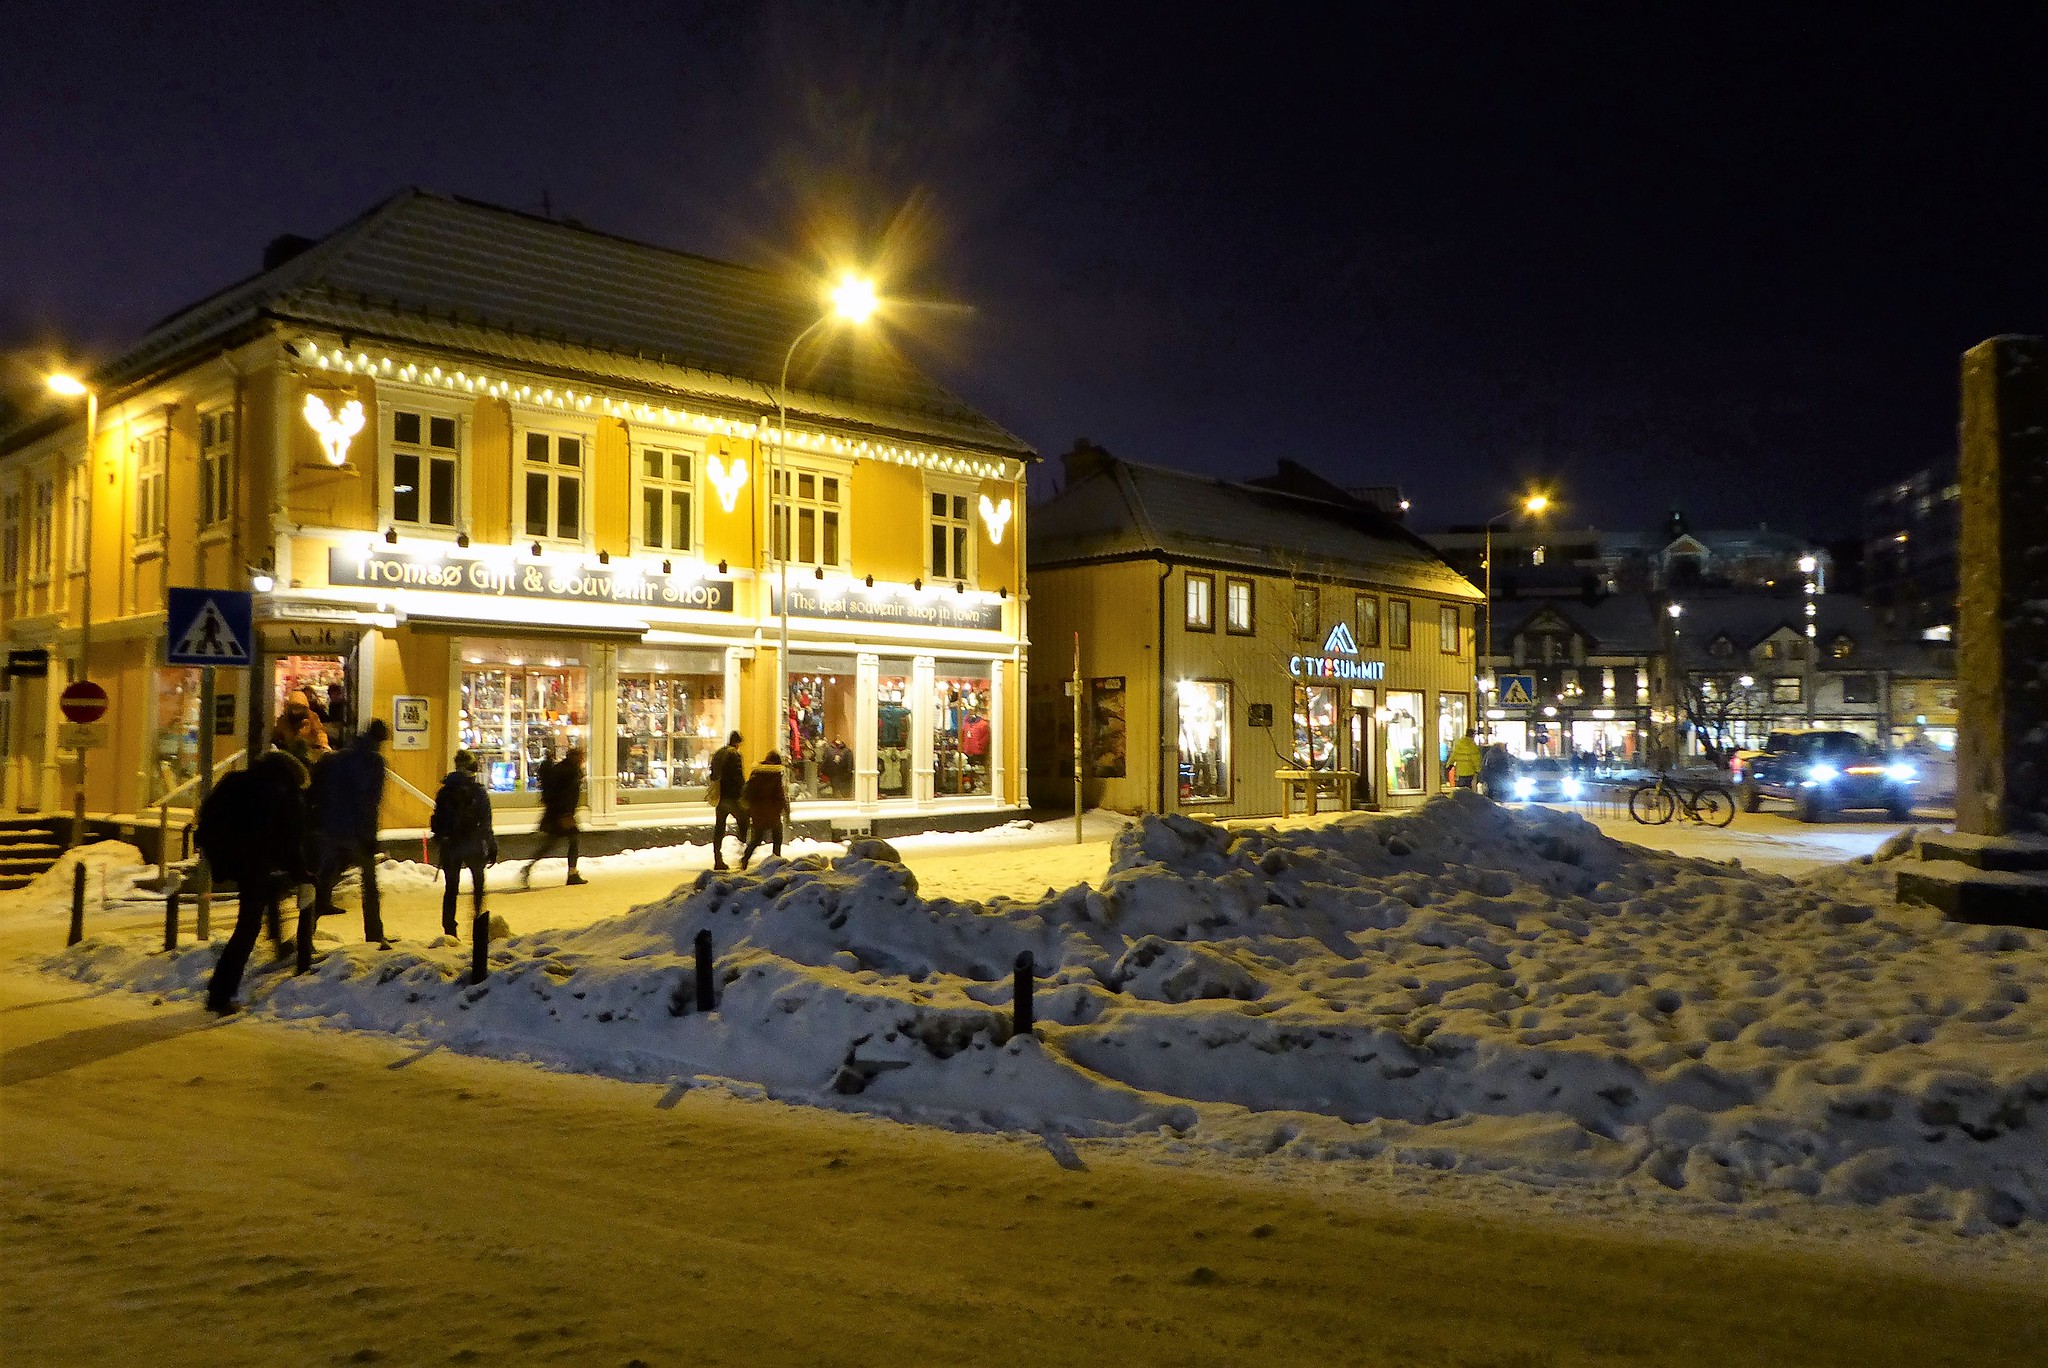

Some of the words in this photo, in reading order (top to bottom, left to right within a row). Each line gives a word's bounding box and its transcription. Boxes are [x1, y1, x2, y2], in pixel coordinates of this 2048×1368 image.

[353, 555, 463, 587] Tromsø
[469, 560, 517, 596] Gift
[523, 565, 544, 593] &
[548, 569, 658, 601] Souvenir
[663, 574, 720, 609] Shop
[791, 592, 816, 612] The
[850, 601, 905, 617] souvenir
[907, 605, 936, 622] shop
[939, 605, 951, 620] in
[1290, 655, 1325, 677] CTY
[1333, 658, 1385, 681] SUMMIT
